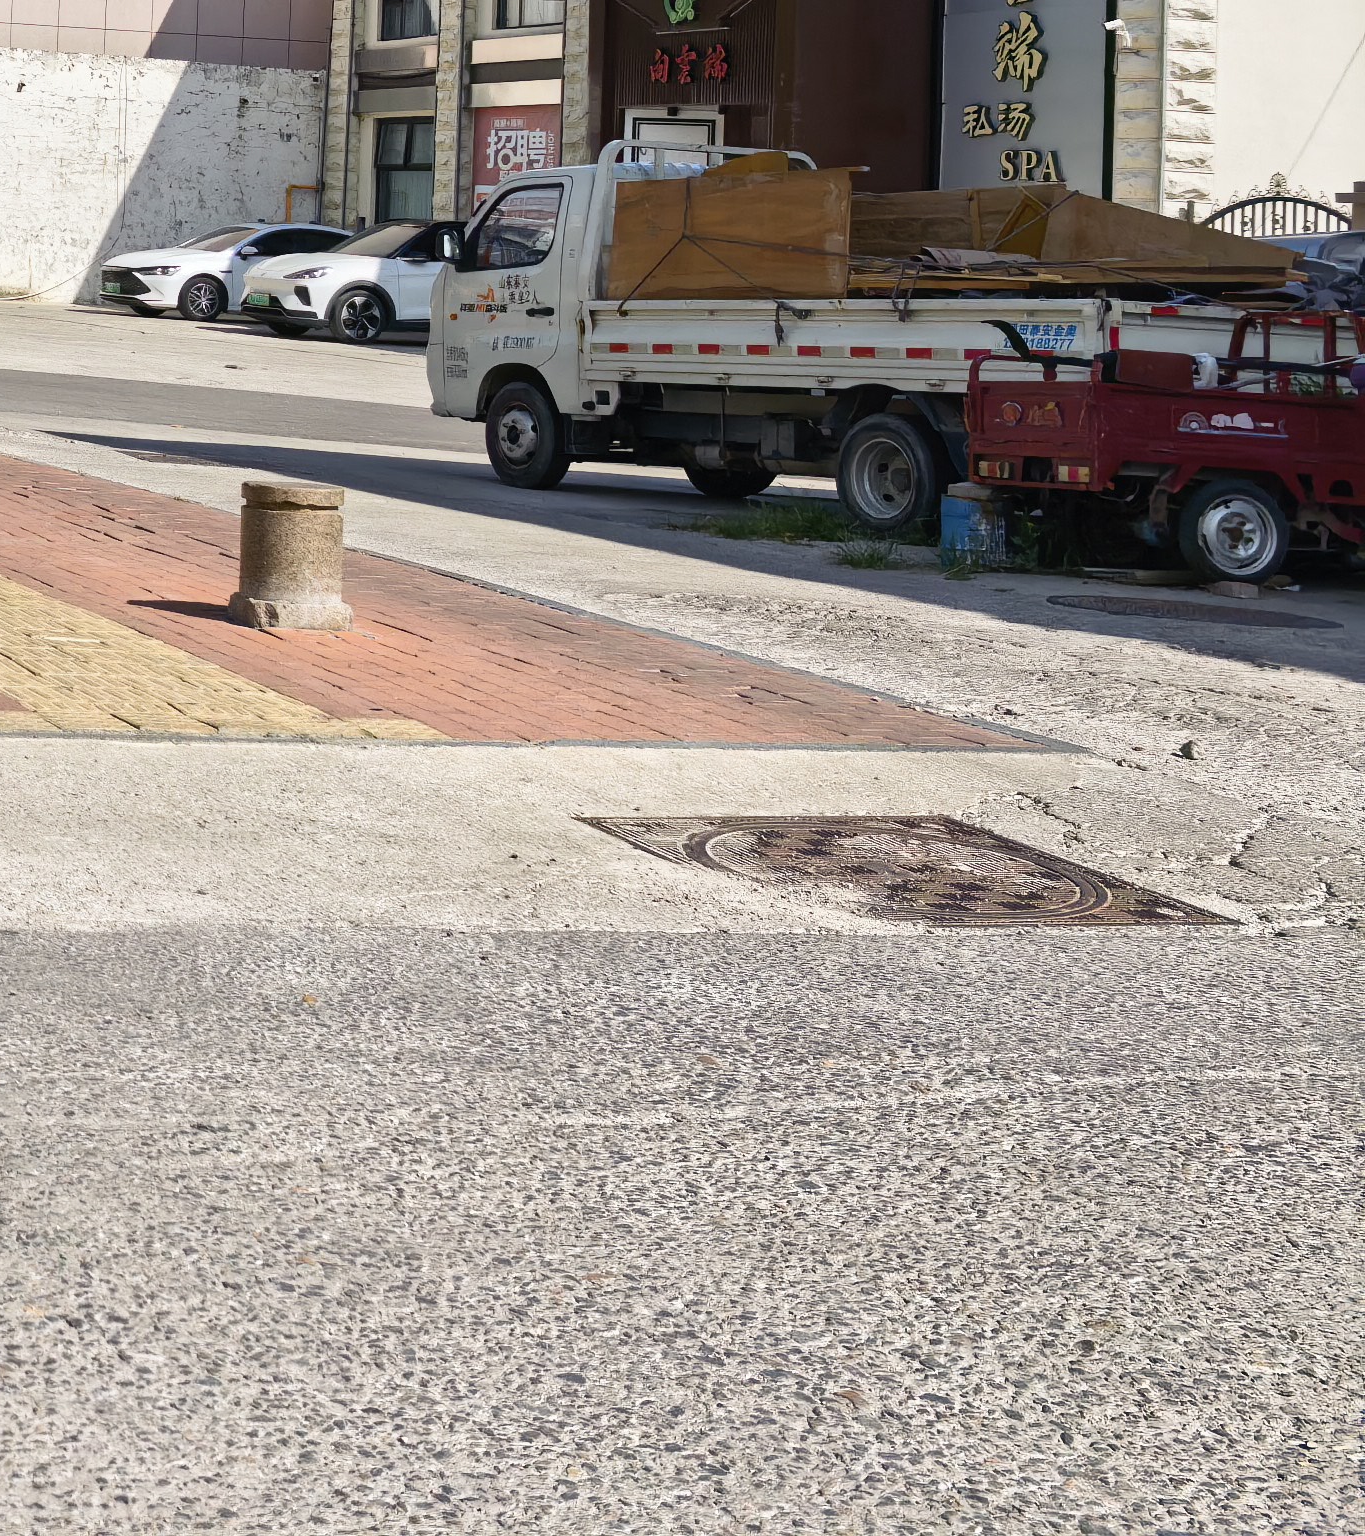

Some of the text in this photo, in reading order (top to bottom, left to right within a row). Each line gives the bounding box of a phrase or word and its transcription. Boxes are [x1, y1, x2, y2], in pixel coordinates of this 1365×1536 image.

[961, 102, 1034, 141] 私汤
[486, 128, 547, 172] 招聘
[999, 149, 1061, 182] SPA
